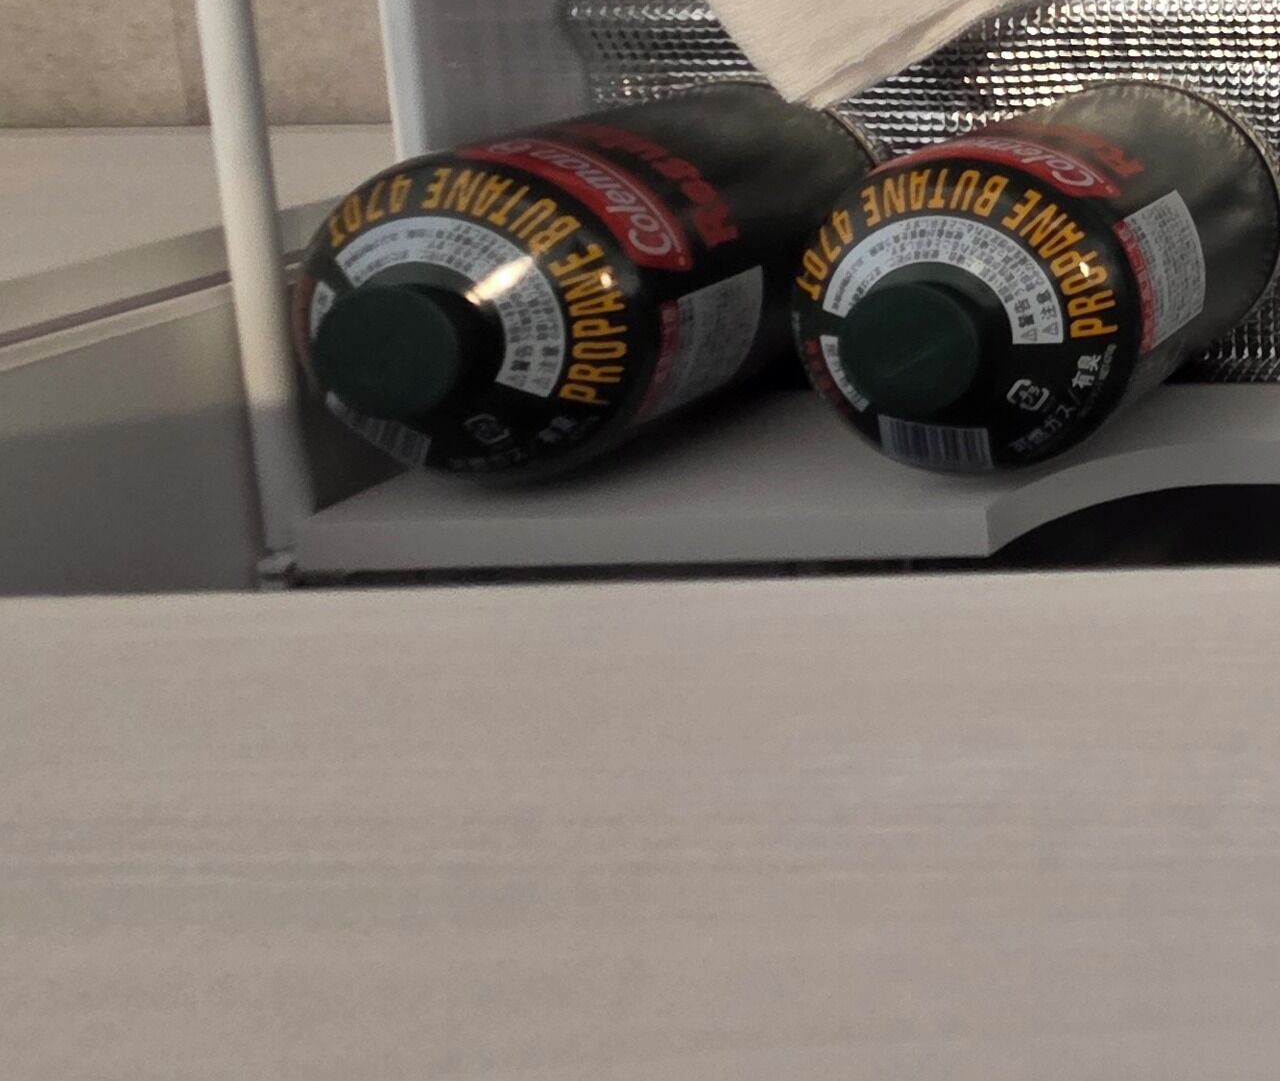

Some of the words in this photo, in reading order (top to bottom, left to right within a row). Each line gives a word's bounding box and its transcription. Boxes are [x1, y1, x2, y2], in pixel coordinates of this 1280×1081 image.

[422, 166, 583, 255] BUTANE
[529, 142, 674, 258] Coleman
[861, 169, 1008, 227] BUTANE
[1001, 189, 1118, 339] PROPANE
[549, 241, 629, 406] PROPANE
